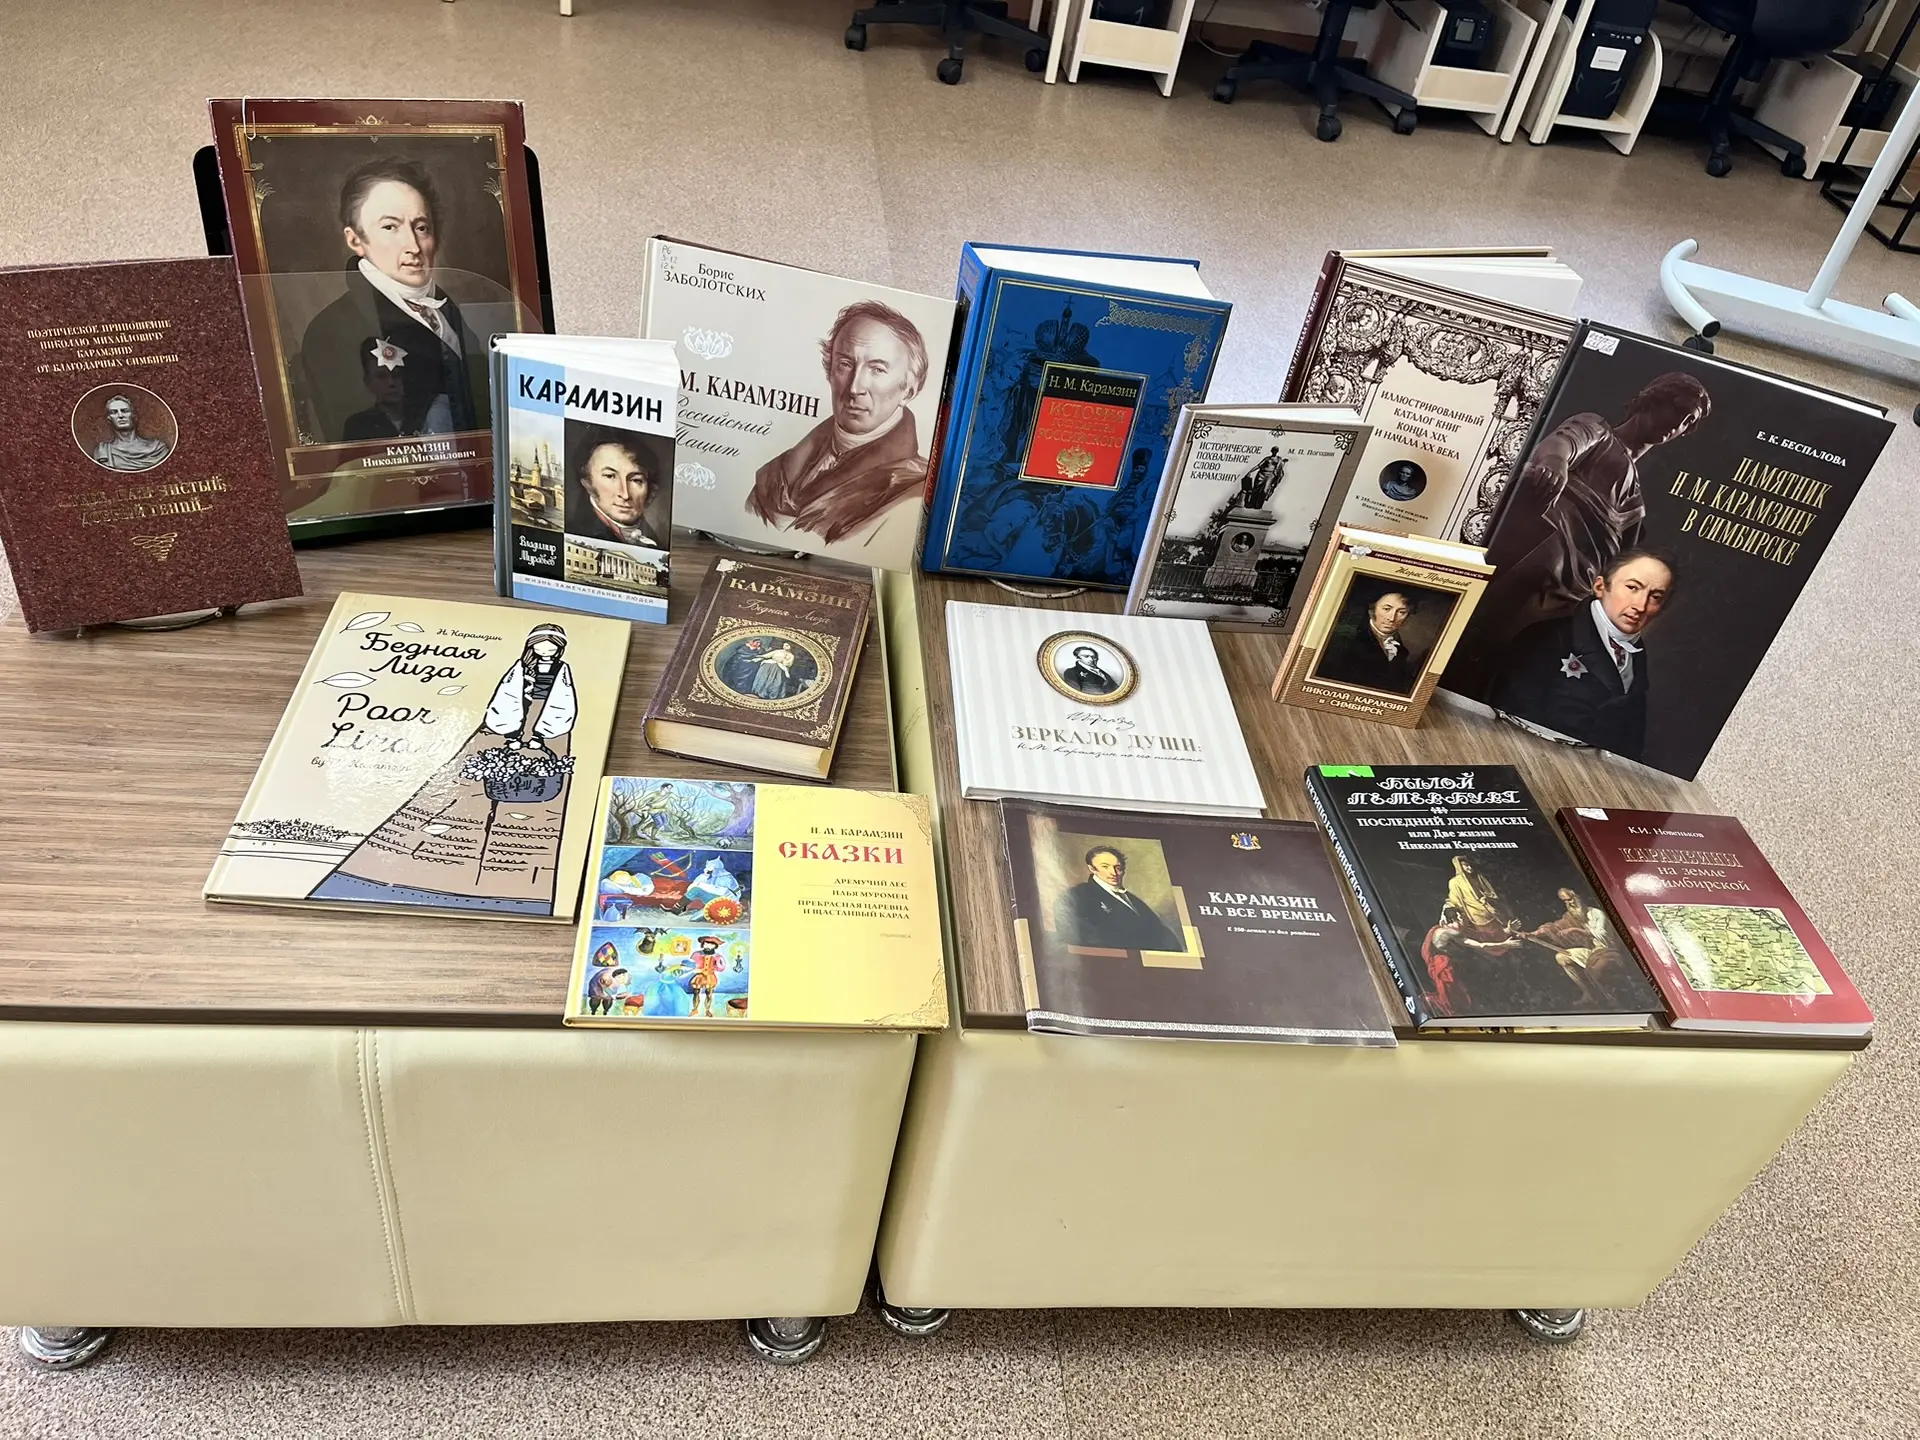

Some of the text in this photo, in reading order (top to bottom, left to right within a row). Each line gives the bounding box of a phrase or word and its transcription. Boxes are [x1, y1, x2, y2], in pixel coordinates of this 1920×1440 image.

[698, 263, 734, 281] Борис
[663, 270, 766, 301] ЗАБОЛОТСКИХ
[27, 319, 172, 339] ПОЭТИЧЕСКОЕ ПРИНОШЕНИЕ
[39, 331, 165, 350] НИКОЛАЮ МИХАЙЛОВИЧУ
[76, 346, 134, 359] КАРАМЗИНУ
[36, 354, 179, 374] ОТ БЛАГОДАРНЫХ СИМБИРЯН
[1048, 375, 1138, 398] Н. М. Карамзин
[518, 373, 663, 423] КАРАМЗИН
[706, 375, 820, 418] КАРАМЗИН
[1380, 390, 1485, 426] ИЛЛЮСТРИРОВАННЫЙ
[1393, 407, 1461, 433] КАТАЛОГ КНИГ
[1396, 421, 1428, 438] КОНЦА
[386, 441, 451, 456] КАРАМЗИН
[1199, 441, 1263, 455] ИСТОРИЧЕСКОЕ
[1374, 428, 1383, 437] И
[1383, 431, 1419, 448] НАЧАЛА
[1436, 446, 1460, 460] ВЕКА
[1756, 430, 1847, 467] Е. К. БЕСПАЛОВА
[362, 449, 476, 468] Николай Михайлович
[1193, 461, 1221, 471] СЛОВО
[1196, 451, 1251, 464] ПОХВАЛЬНОЕ
[1190, 471, 1241, 483] КАРАМЗИНУ
[1731, 456, 1833, 509] ПАМЯТНИК
[1668, 470, 1818, 537] Н. М. КАРАМЗИНУ
[1680, 508, 1801, 567] В СИМБИРСКЕ
[1395, 566, 1472, 588] Жорес Трофимов
[524, 577, 654, 604] ЖИЗНЬ ЗАМЕЧАТЕЛЬНЫХ ЛЮДЕЙ
[729, 578, 855, 609] КАРАМЗИН
[738, 598, 832, 625] Бедная Лиза
[450, 629, 503, 641] Карамзин
[360, 631, 487, 661] Бедная
[369, 655, 462, 683] Лиза
[337, 692, 439, 724] Poor
[1301, 685, 1408, 712] НИКОЛАЙ КАРАМЗИН
[1330, 699, 1384, 716] СИМБИРСК
[1011, 725, 1117, 747] ЗЕРКАЛО
[1053, 746, 1118, 758] Карамзин
[1376, 771, 1476, 790] БЫЛОЙ
[1347, 791, 1521, 805] ПЕТЕРБУРГ
[1356, 816, 1534, 827] ПОСЛЕДНИЙ ЛЕТОПИСЕЦ,
[810, 827, 904, 840] Н. М. КАРАМЗИН
[1433, 829, 1456, 839] Две
[1457, 830, 1496, 838] жизни
[1628, 826, 1705, 838] К.И. Новеньков
[778, 841, 905, 864] СКАЗКИ
[1398, 841, 1519, 851] Николая Карамзина
[1618, 847, 1744, 868] КАРАМЗИНЫ
[1656, 866, 1727, 878] на земле
[834, 878, 888, 887] ДРЕМУЧИЙ
[860, 891, 909, 900] МУРОМЕЦ
[1208, 891, 1319, 910] КАРАМЗИН
[797, 900, 910, 911] ПРЕКРАСНАЯ ЦАРЕВНА
[812, 909, 877, 918] ЩАСТЛИВЫЙ
[879, 912, 910, 920] КАРЛА
[1199, 905, 1337, 923] НА ВСЕ ВРЕМЕНА
